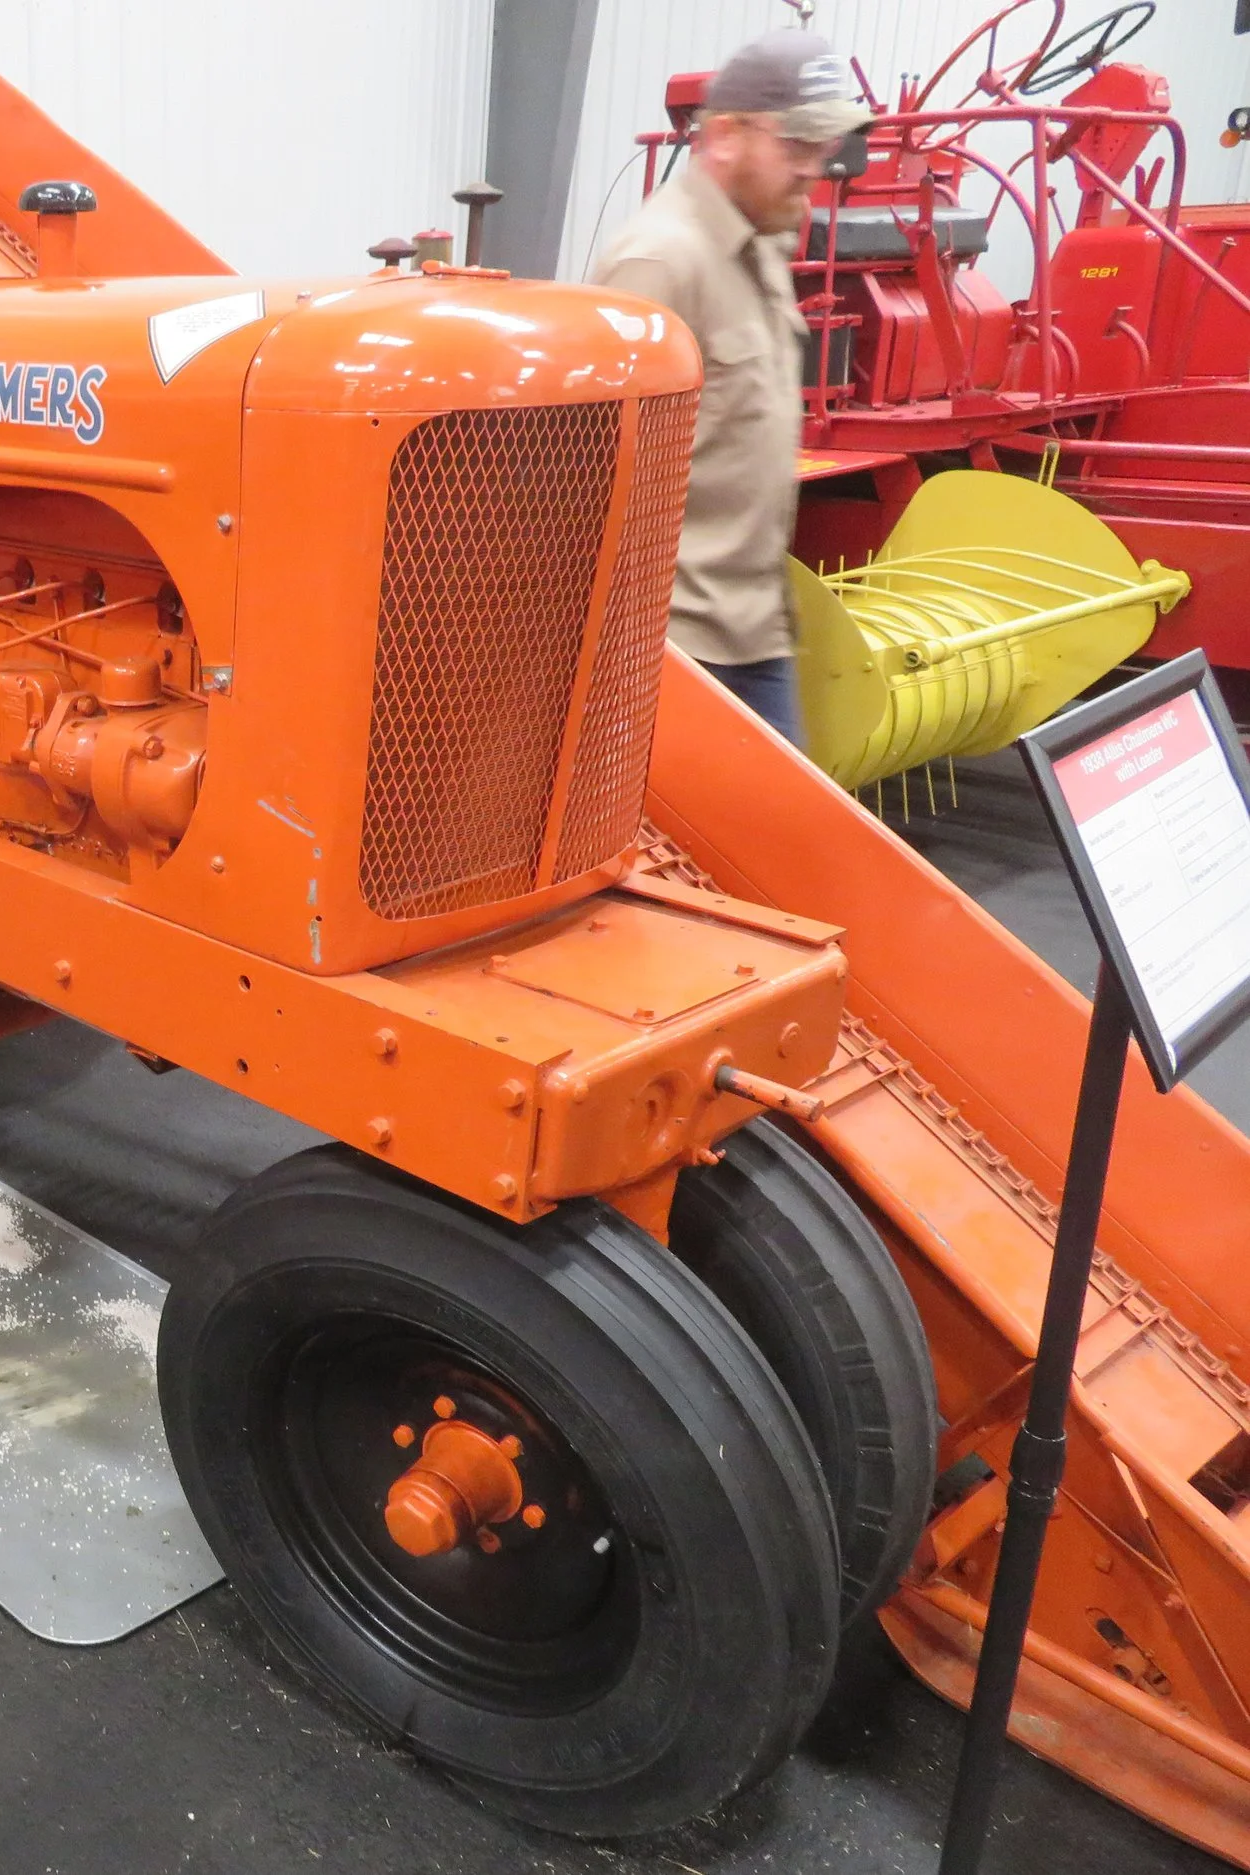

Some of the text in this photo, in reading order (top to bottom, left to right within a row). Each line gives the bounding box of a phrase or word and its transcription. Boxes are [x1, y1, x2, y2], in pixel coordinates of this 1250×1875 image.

[1080, 267, 1119, 279] 1281
[1103, 743, 1125, 762] Allis
[1122, 724, 1164, 751] Chalmers
[1159, 710, 1179, 730] WC
[1115, 746, 1164, 782] with Loader
